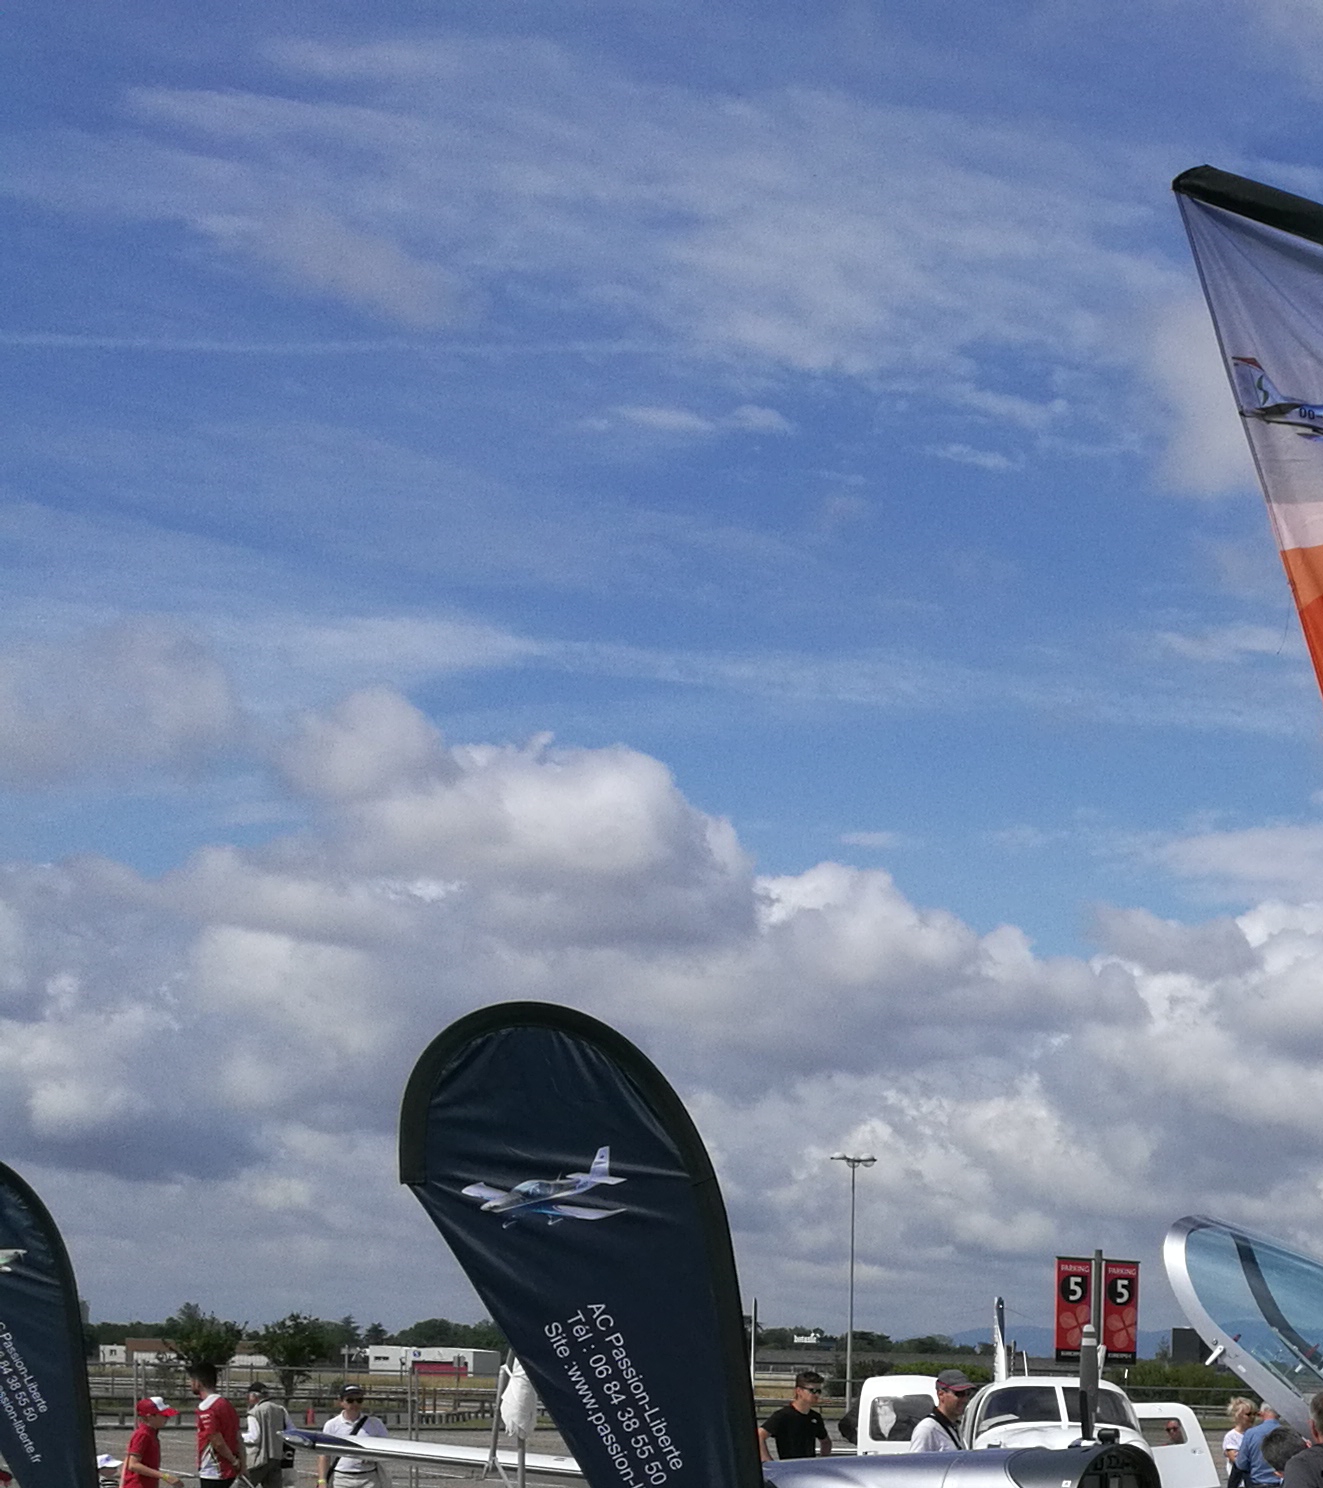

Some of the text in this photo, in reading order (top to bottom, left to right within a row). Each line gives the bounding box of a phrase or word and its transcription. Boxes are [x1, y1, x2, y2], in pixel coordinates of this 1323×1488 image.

[1061, 1264, 1090, 1274] PARKING
[1108, 1267, 1136, 1276] PARKING
[1069, 1276, 1082, 1300] 5
[1116, 1279, 1130, 1304] 5
[544, 1322, 570, 1358] Site
[14, 1391, 31, 1407] 55
[587, 1303, 683, 1471] AC Passion-Liberte
[22, 1406, 39, 1422] 50
[589, 1354, 612, 1379] 06
[603, 1381, 626, 1405] 84
[617, 1407, 640, 1432] 38
[631, 1434, 655, 1459] 55
[645, 1461, 667, 1486] 50
